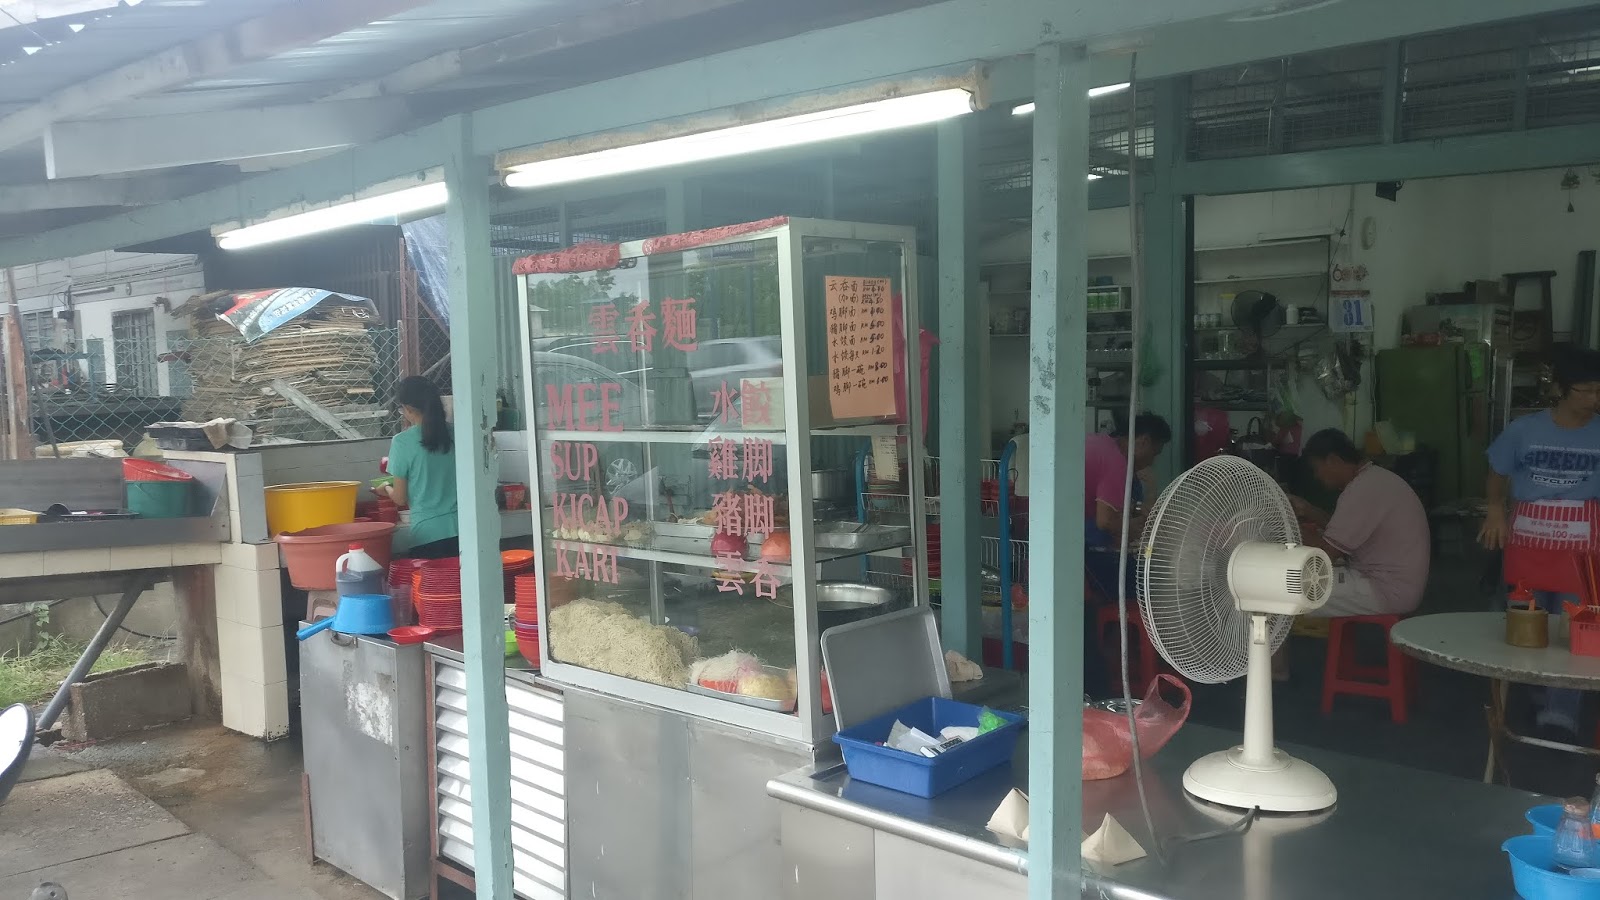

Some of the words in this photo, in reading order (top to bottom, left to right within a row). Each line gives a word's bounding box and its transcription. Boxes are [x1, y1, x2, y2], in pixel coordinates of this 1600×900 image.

[545, 382, 624, 433] MEE
[709, 379, 772, 427] 水餃
[550, 441, 600, 482] SUP
[552, 492, 630, 537] KICAP
[1552, 530, 1568, 539] 100
[555, 543, 620, 585] KARI
